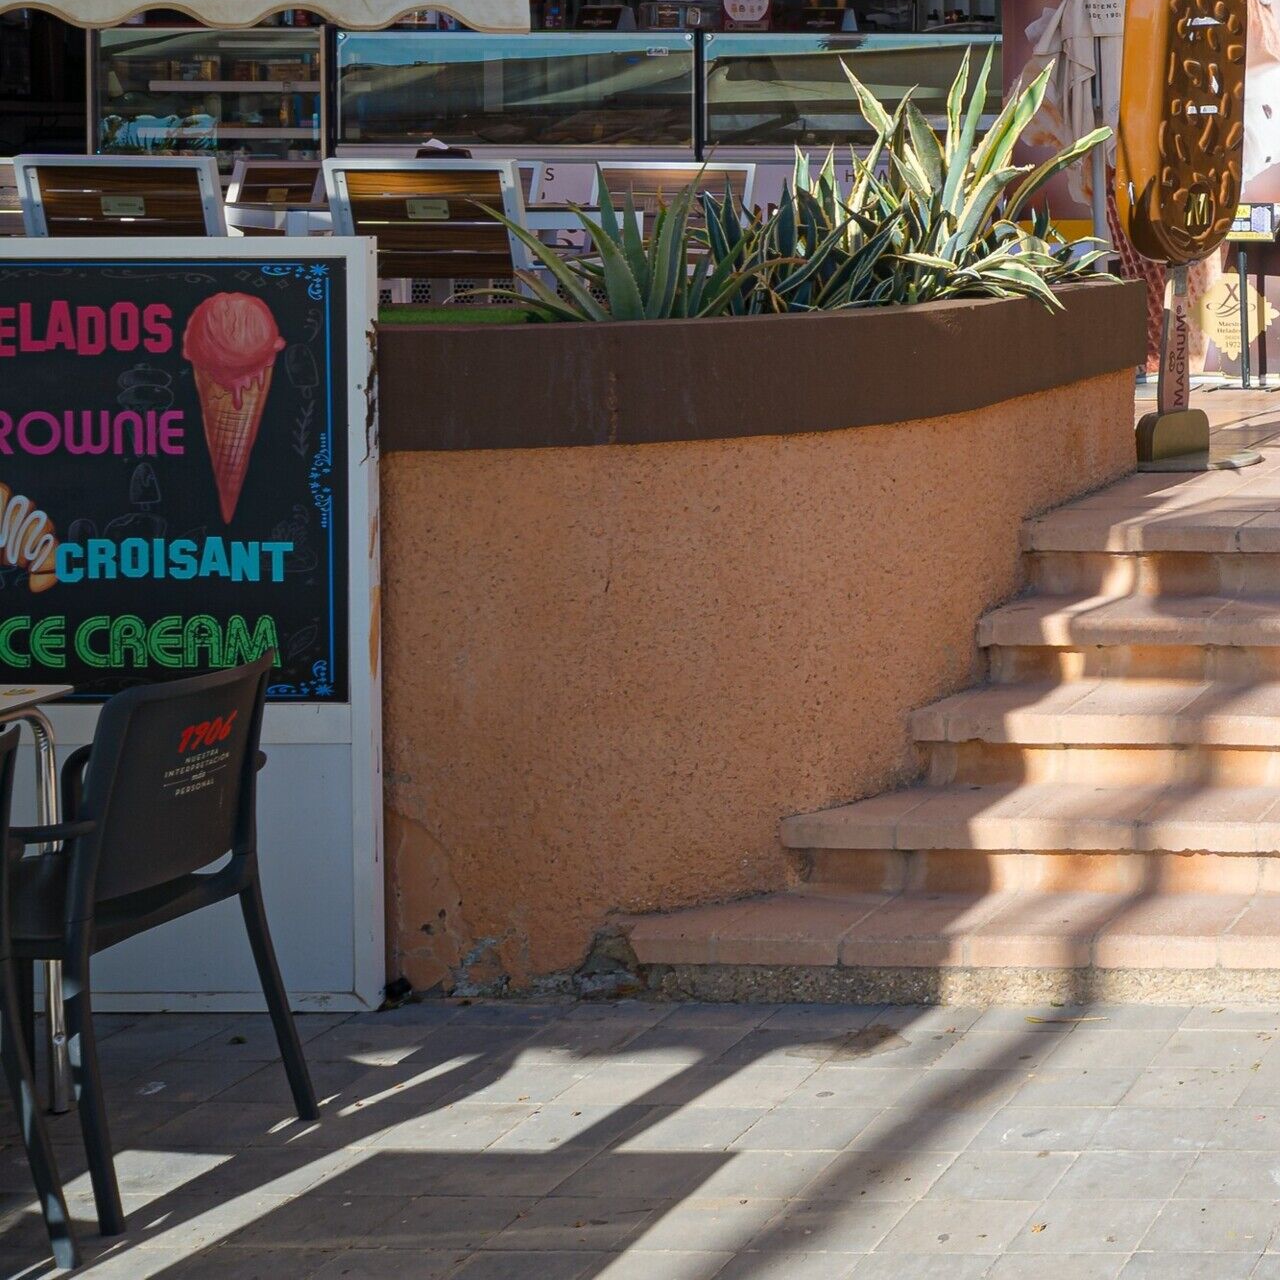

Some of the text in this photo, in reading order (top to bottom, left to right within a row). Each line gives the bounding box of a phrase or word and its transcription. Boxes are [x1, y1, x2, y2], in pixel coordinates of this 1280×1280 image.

[55, 536, 294, 583] CROISANT
[74, 614, 282, 669] CREAM
[178, 709, 238, 753] 1906
